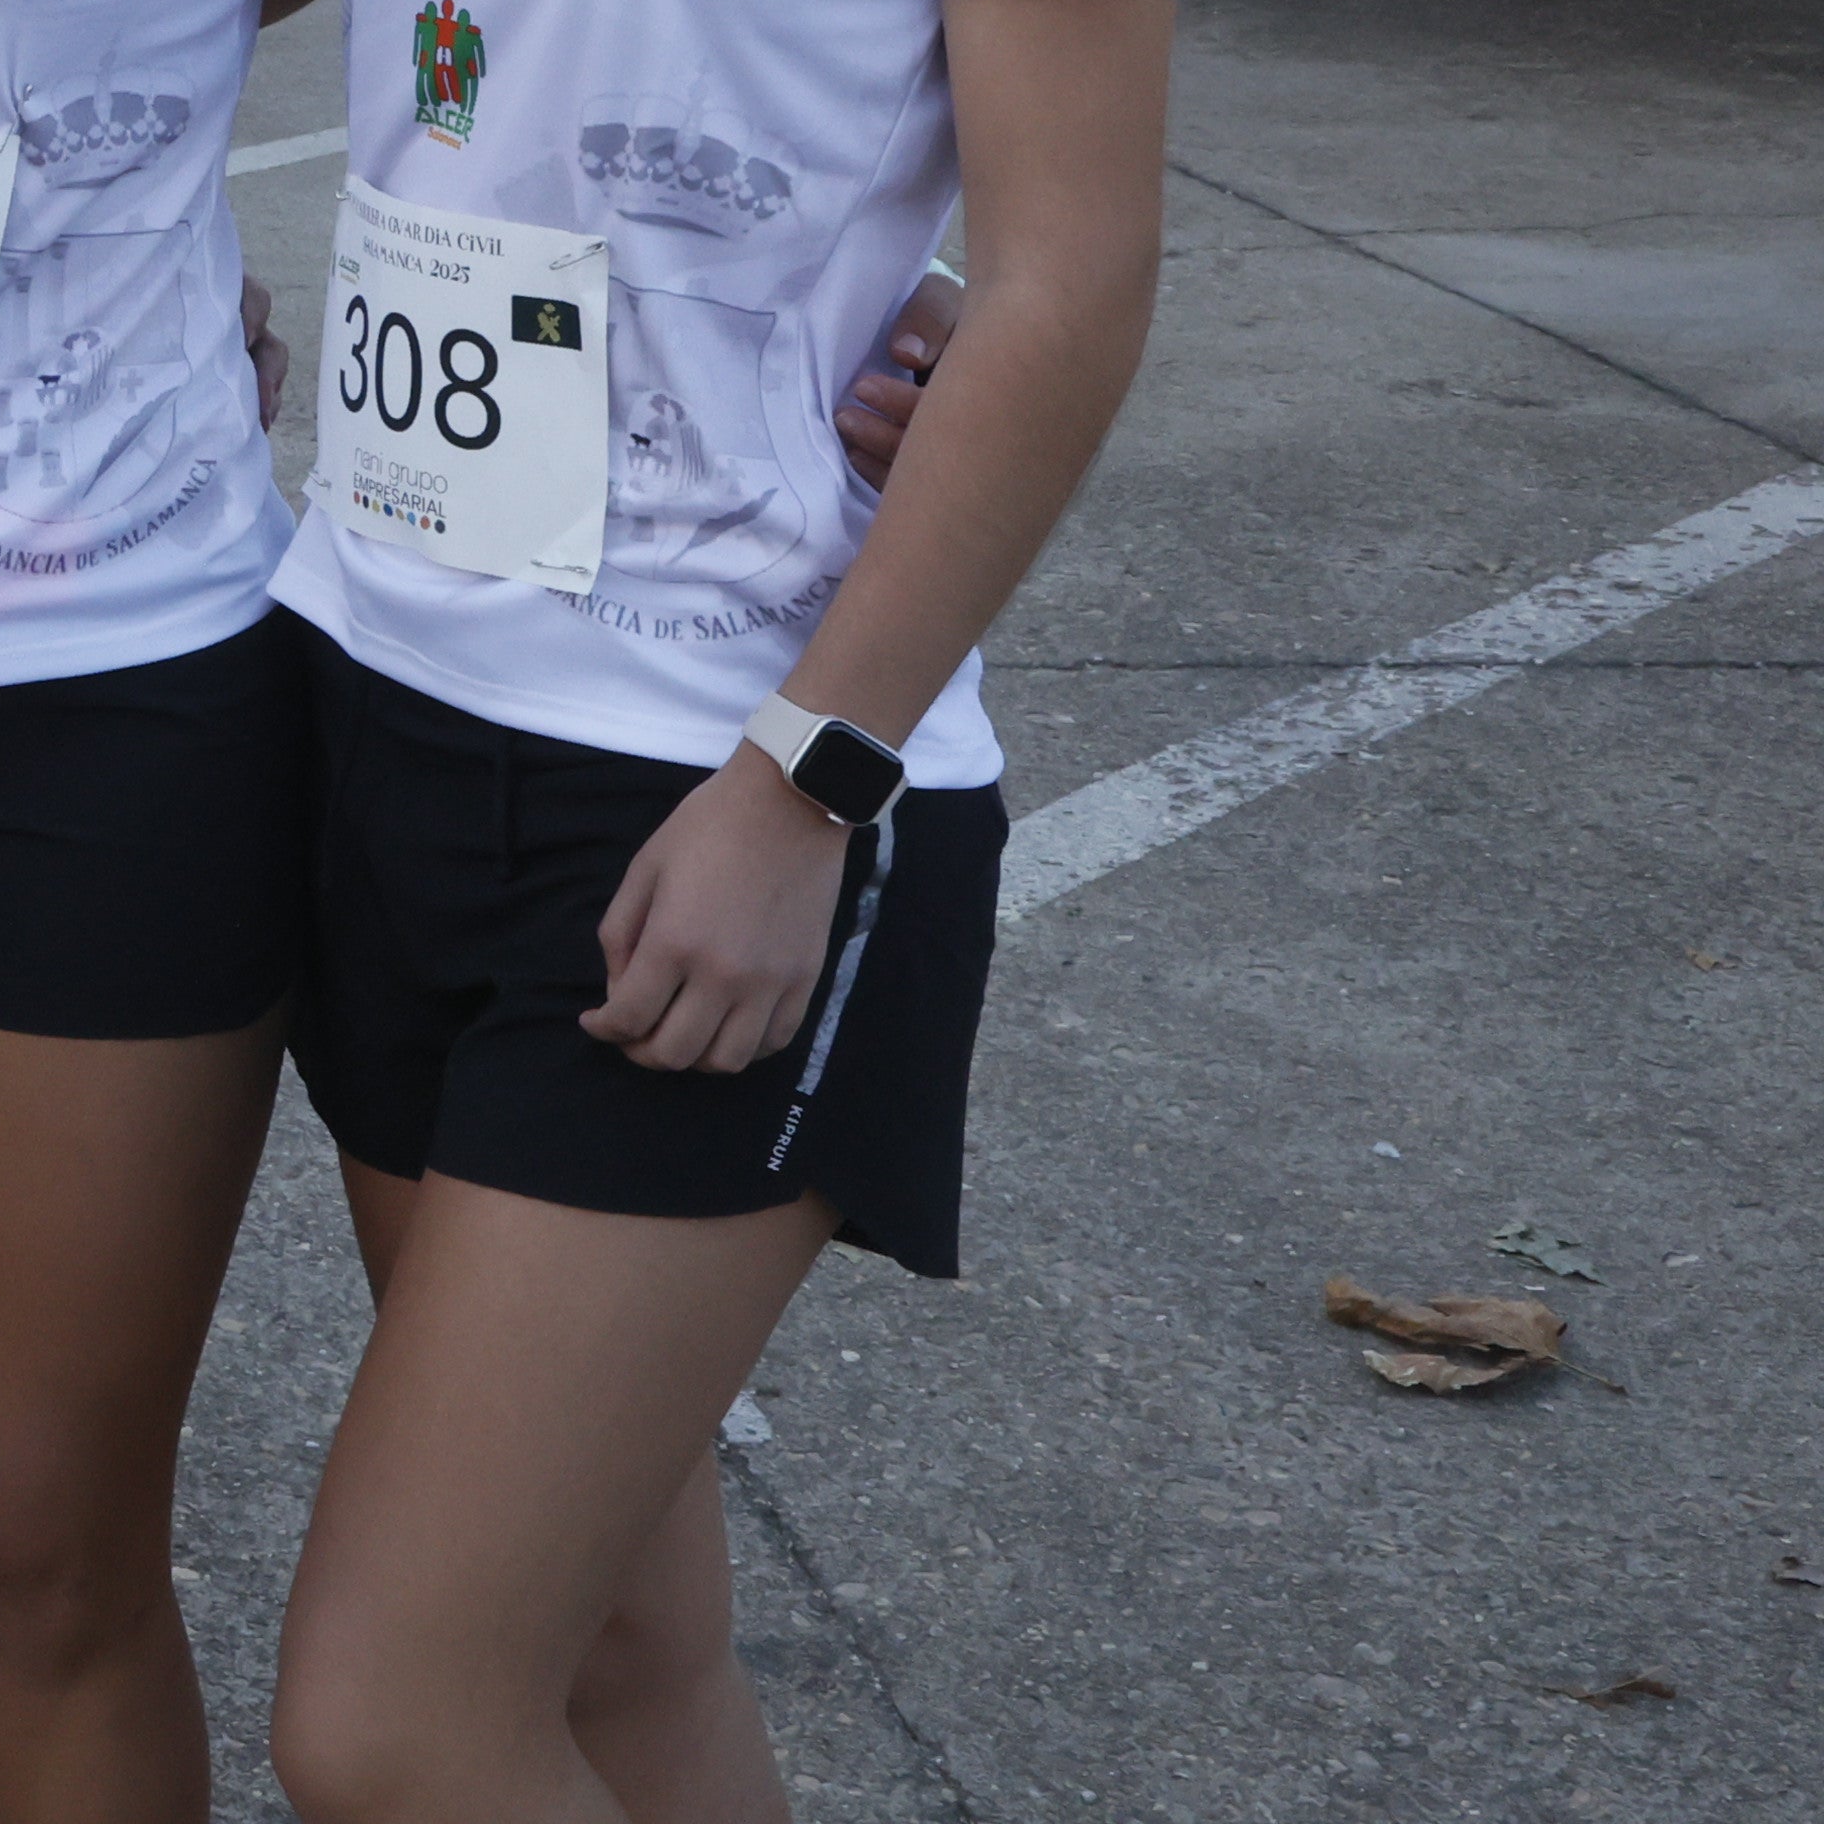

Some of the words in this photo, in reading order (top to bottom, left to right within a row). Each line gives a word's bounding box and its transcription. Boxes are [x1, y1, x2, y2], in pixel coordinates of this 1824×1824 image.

[415, 106, 475, 144] ALCER
[429, 258, 471, 285] 2025
[339, 294, 502, 451] 308
[353, 444, 383, 478] nani
[388, 458, 449, 495] grupo
[75, 548, 101, 571] DE
[105, 458, 218, 559] SALAMANCA
[353, 470, 447, 520] EMPRESARIAL
[654, 617, 684, 641] DE
[765, 1102, 805, 1173] KIPRUN
